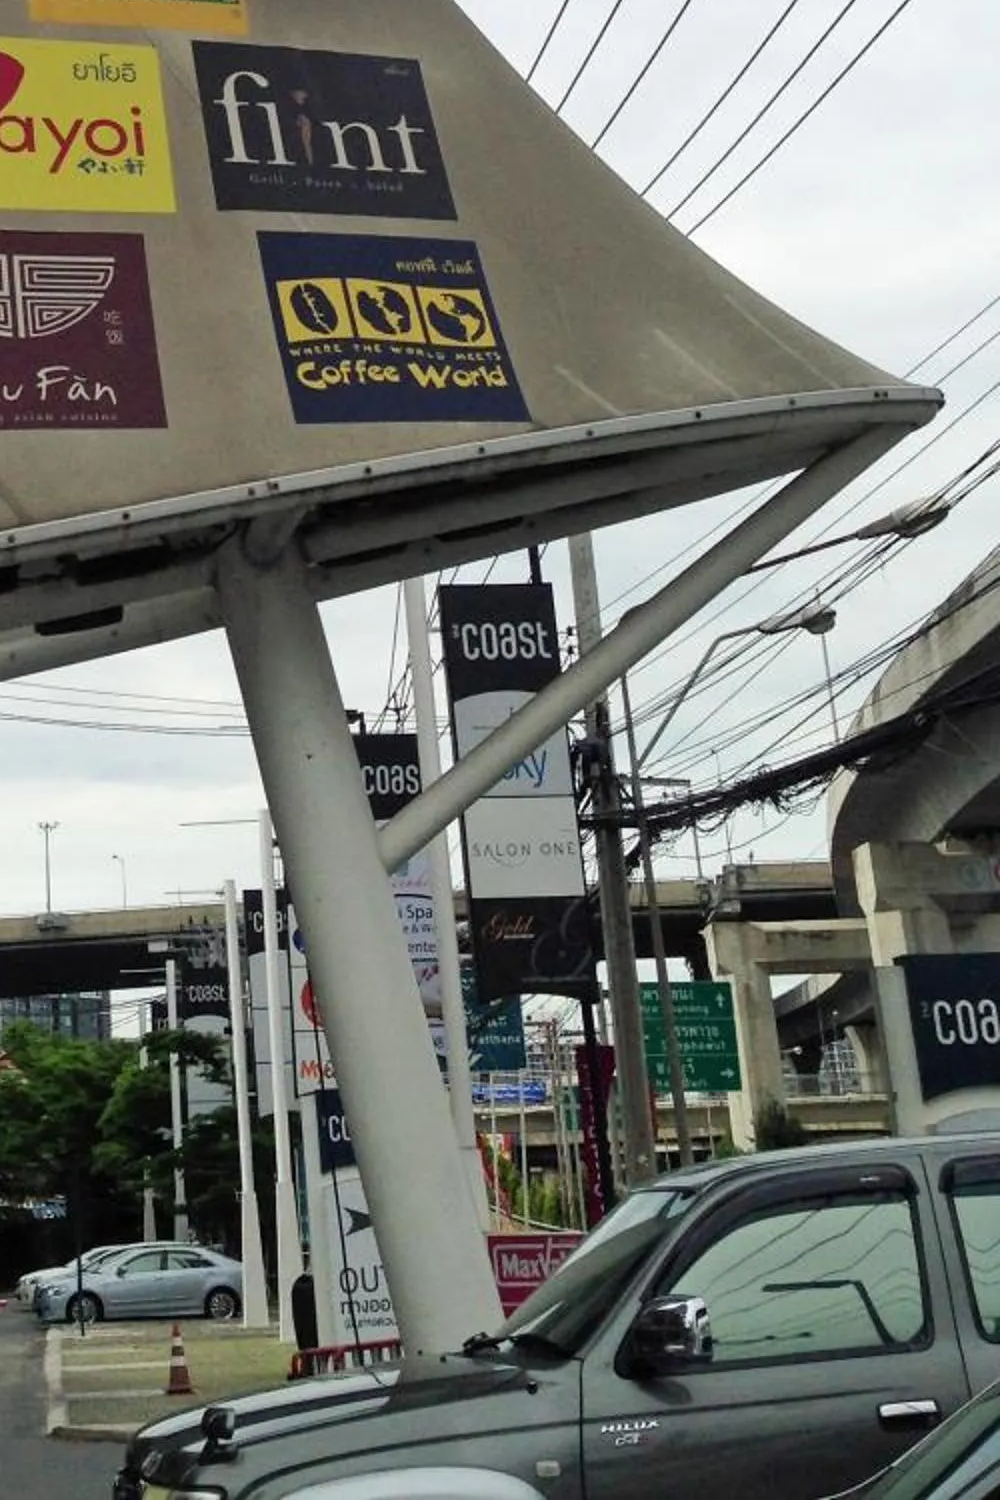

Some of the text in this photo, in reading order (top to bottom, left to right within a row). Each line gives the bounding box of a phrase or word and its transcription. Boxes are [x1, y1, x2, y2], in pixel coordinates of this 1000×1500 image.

[296, 359, 508, 390] Coffee World
[462, 621, 552, 660] coast
[362, 765, 420, 795] coas
[539, 841, 577, 856] ONE
[933, 999, 1000, 1045] coa
[501, 1237, 566, 1279] MaxV
[340, 1265, 384, 1293] OU
